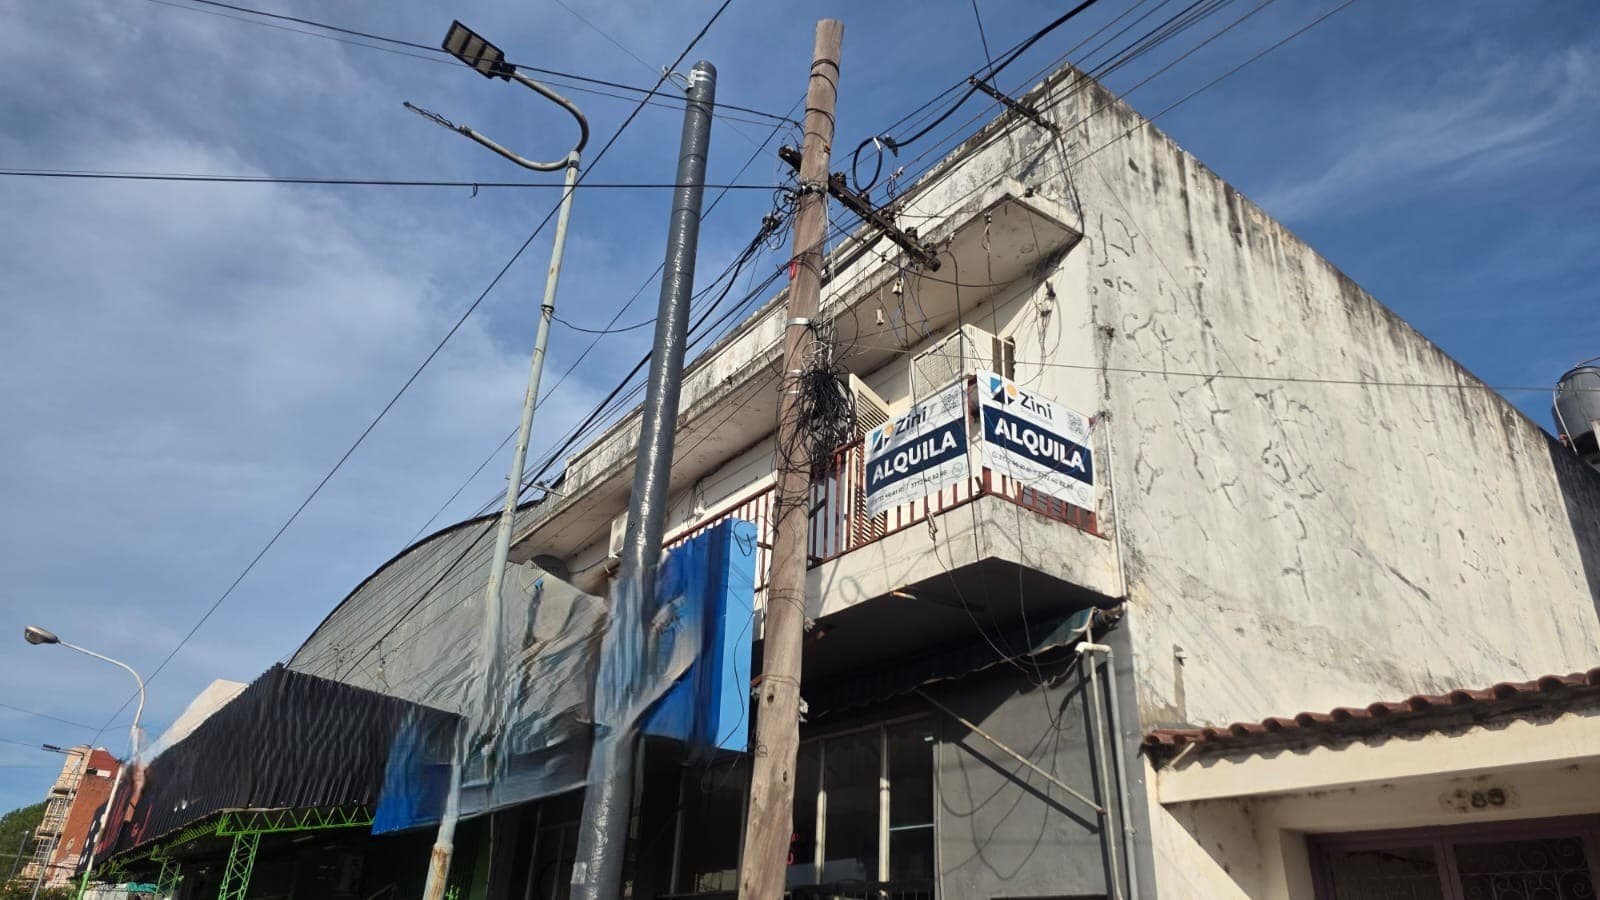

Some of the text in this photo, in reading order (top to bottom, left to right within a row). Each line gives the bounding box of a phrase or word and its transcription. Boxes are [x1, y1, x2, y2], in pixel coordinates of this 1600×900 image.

[896, 406, 927, 434] Zini
[1019, 392, 1053, 420] Zini
[872, 431, 958, 485] ALQUILA
[995, 418, 1085, 473] ALQUILA
